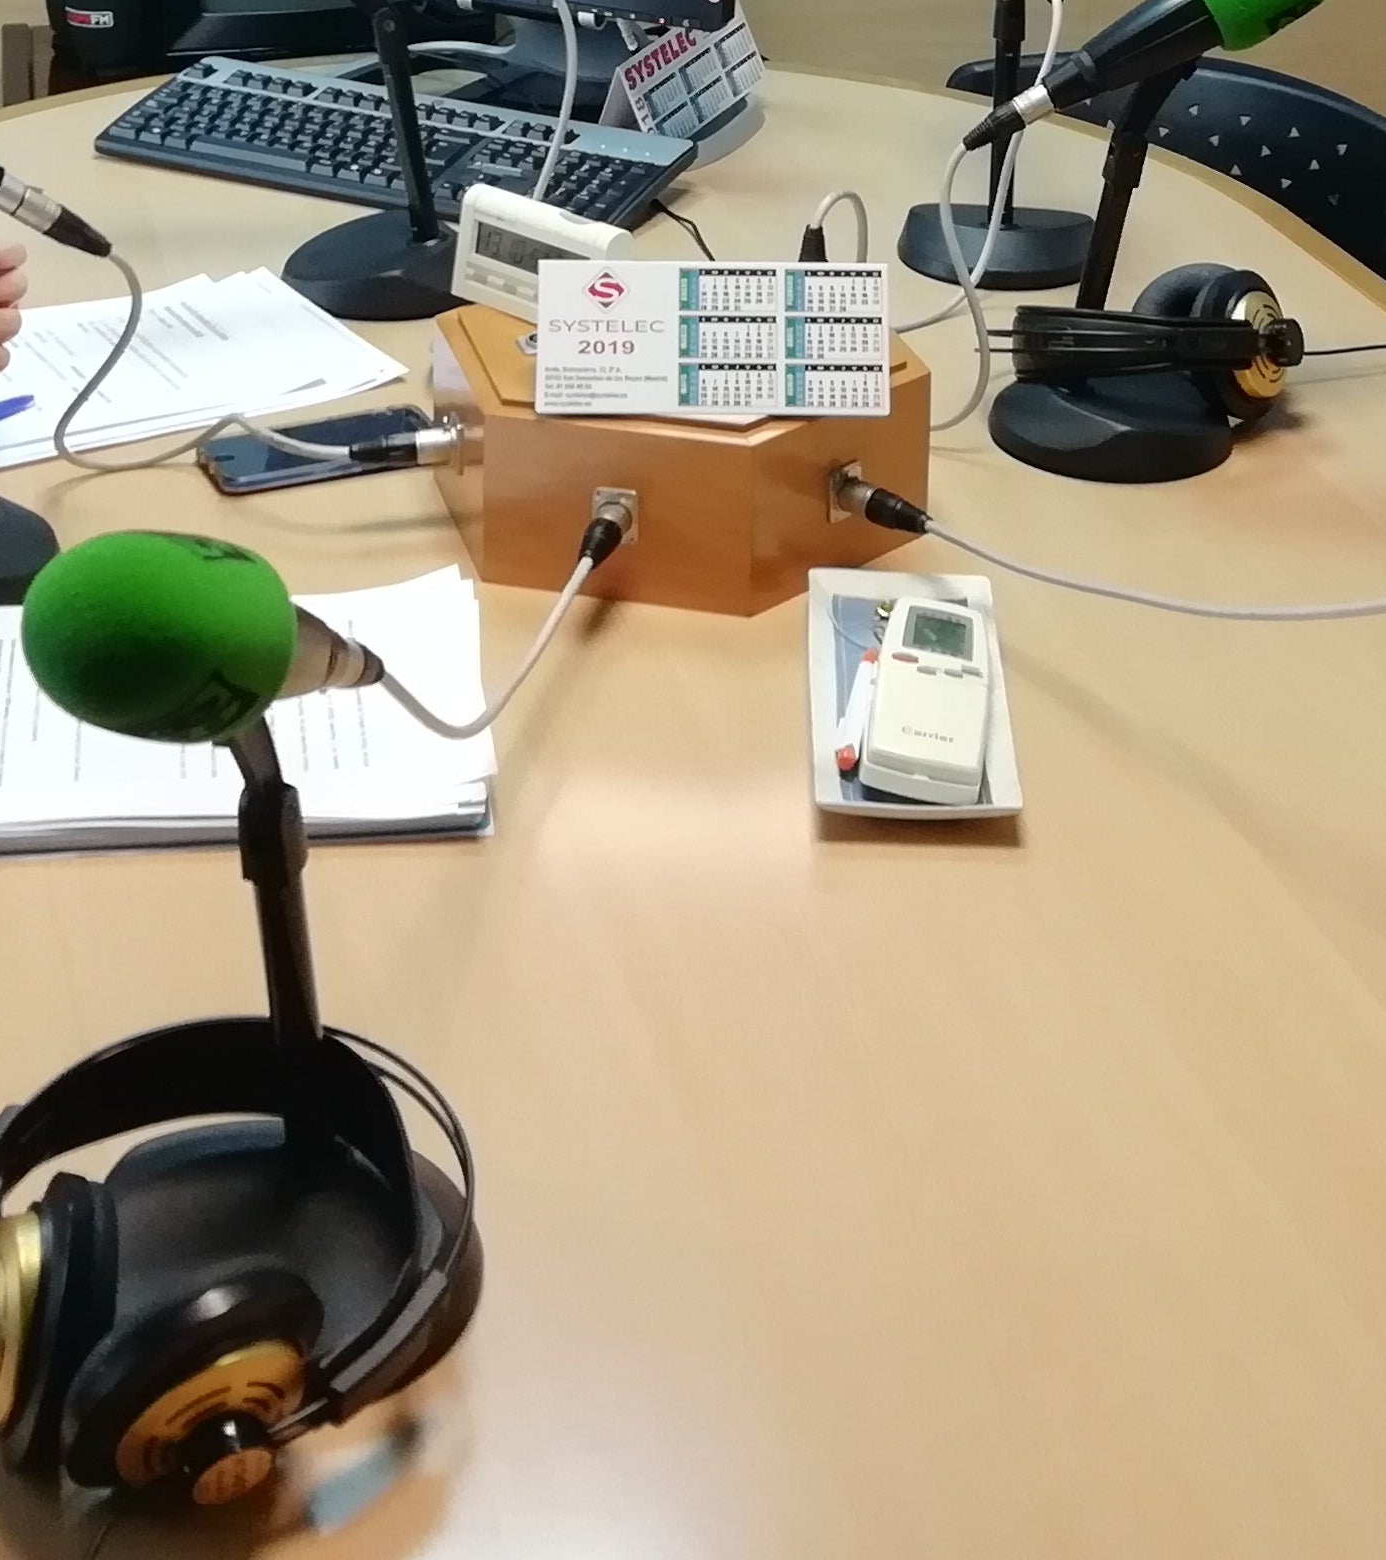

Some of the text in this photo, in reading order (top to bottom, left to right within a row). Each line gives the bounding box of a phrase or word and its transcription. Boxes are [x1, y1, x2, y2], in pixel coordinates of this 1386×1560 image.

[624, 27, 697, 90] SYSTELEC
[549, 319, 665, 333] SYSTELEC
[578, 340, 635, 355] 2019
